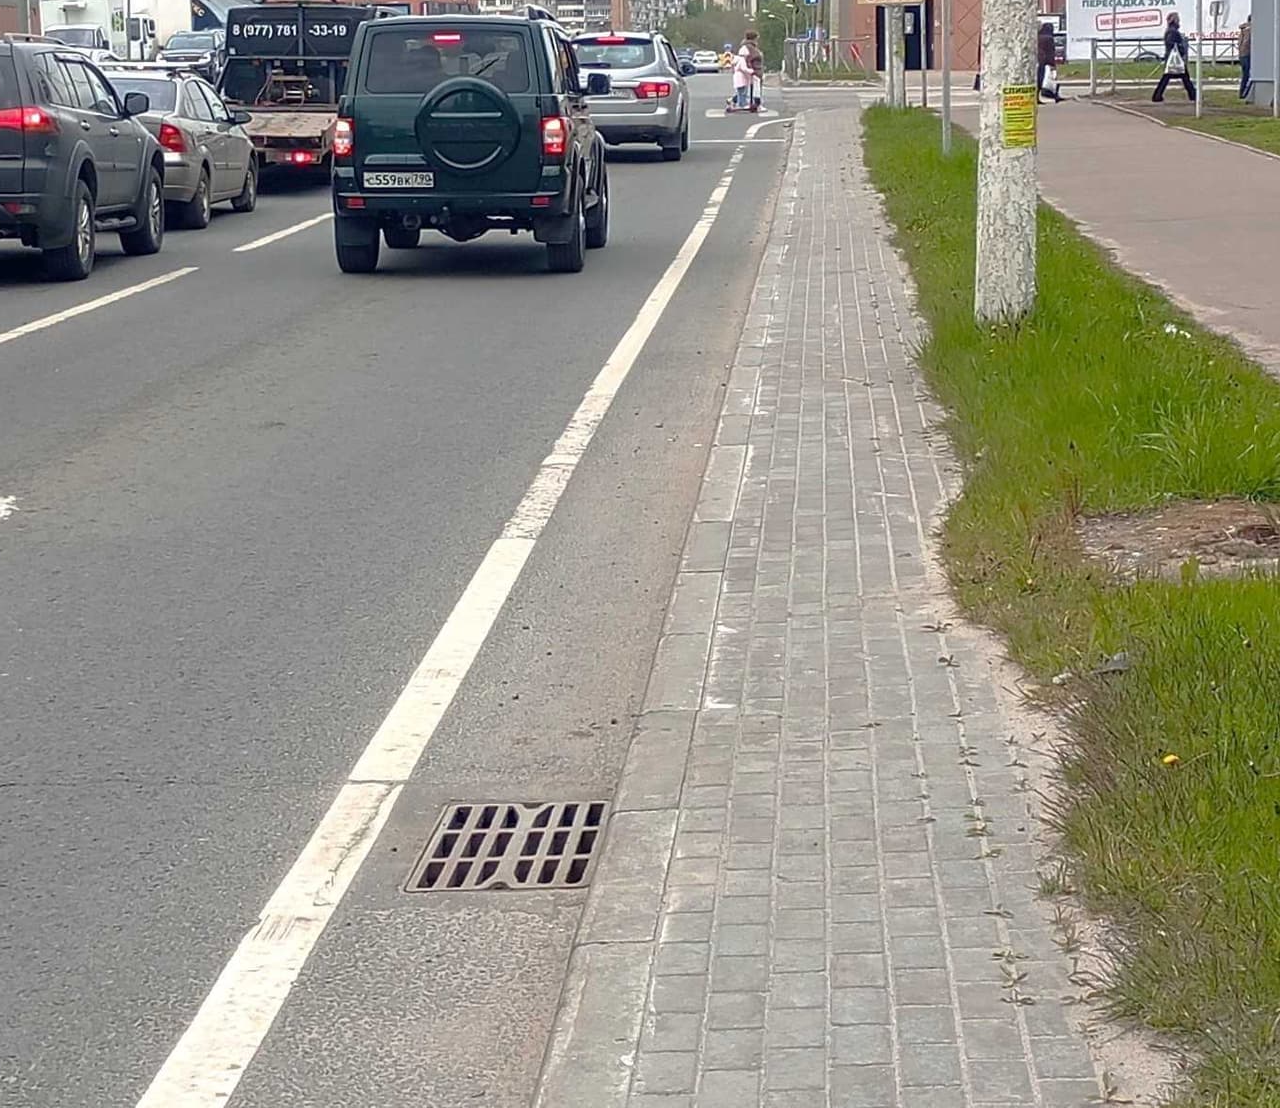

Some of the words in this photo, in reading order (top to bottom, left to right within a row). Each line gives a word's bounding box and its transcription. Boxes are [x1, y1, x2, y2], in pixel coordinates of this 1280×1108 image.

[232, 24, 241, 36] 8
[243, 22, 273, 38] (977)
[276, 24, 298, 36] 781
[308, 24, 347, 36] -33-19
